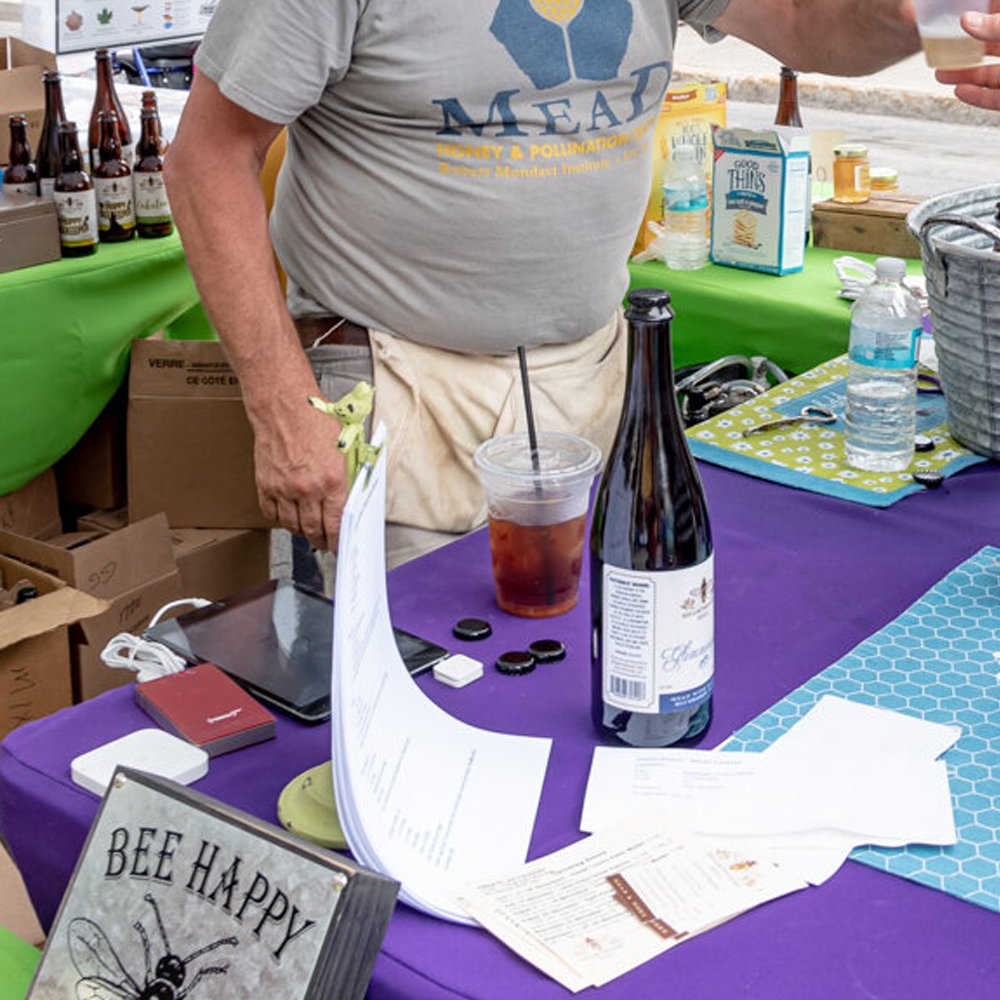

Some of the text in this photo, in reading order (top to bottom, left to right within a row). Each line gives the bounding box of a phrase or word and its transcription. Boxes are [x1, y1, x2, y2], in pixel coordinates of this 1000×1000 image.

[432, 61, 672, 137] MEAD
[436, 143, 504, 160] HONEY
[509, 143, 523, 160] &
[530, 132, 630, 159] POLLINATION
[734, 159, 760, 172] GOOD
[148, 358, 185, 369] VERRE
[104, 827, 316, 962] BEE HAPPY
